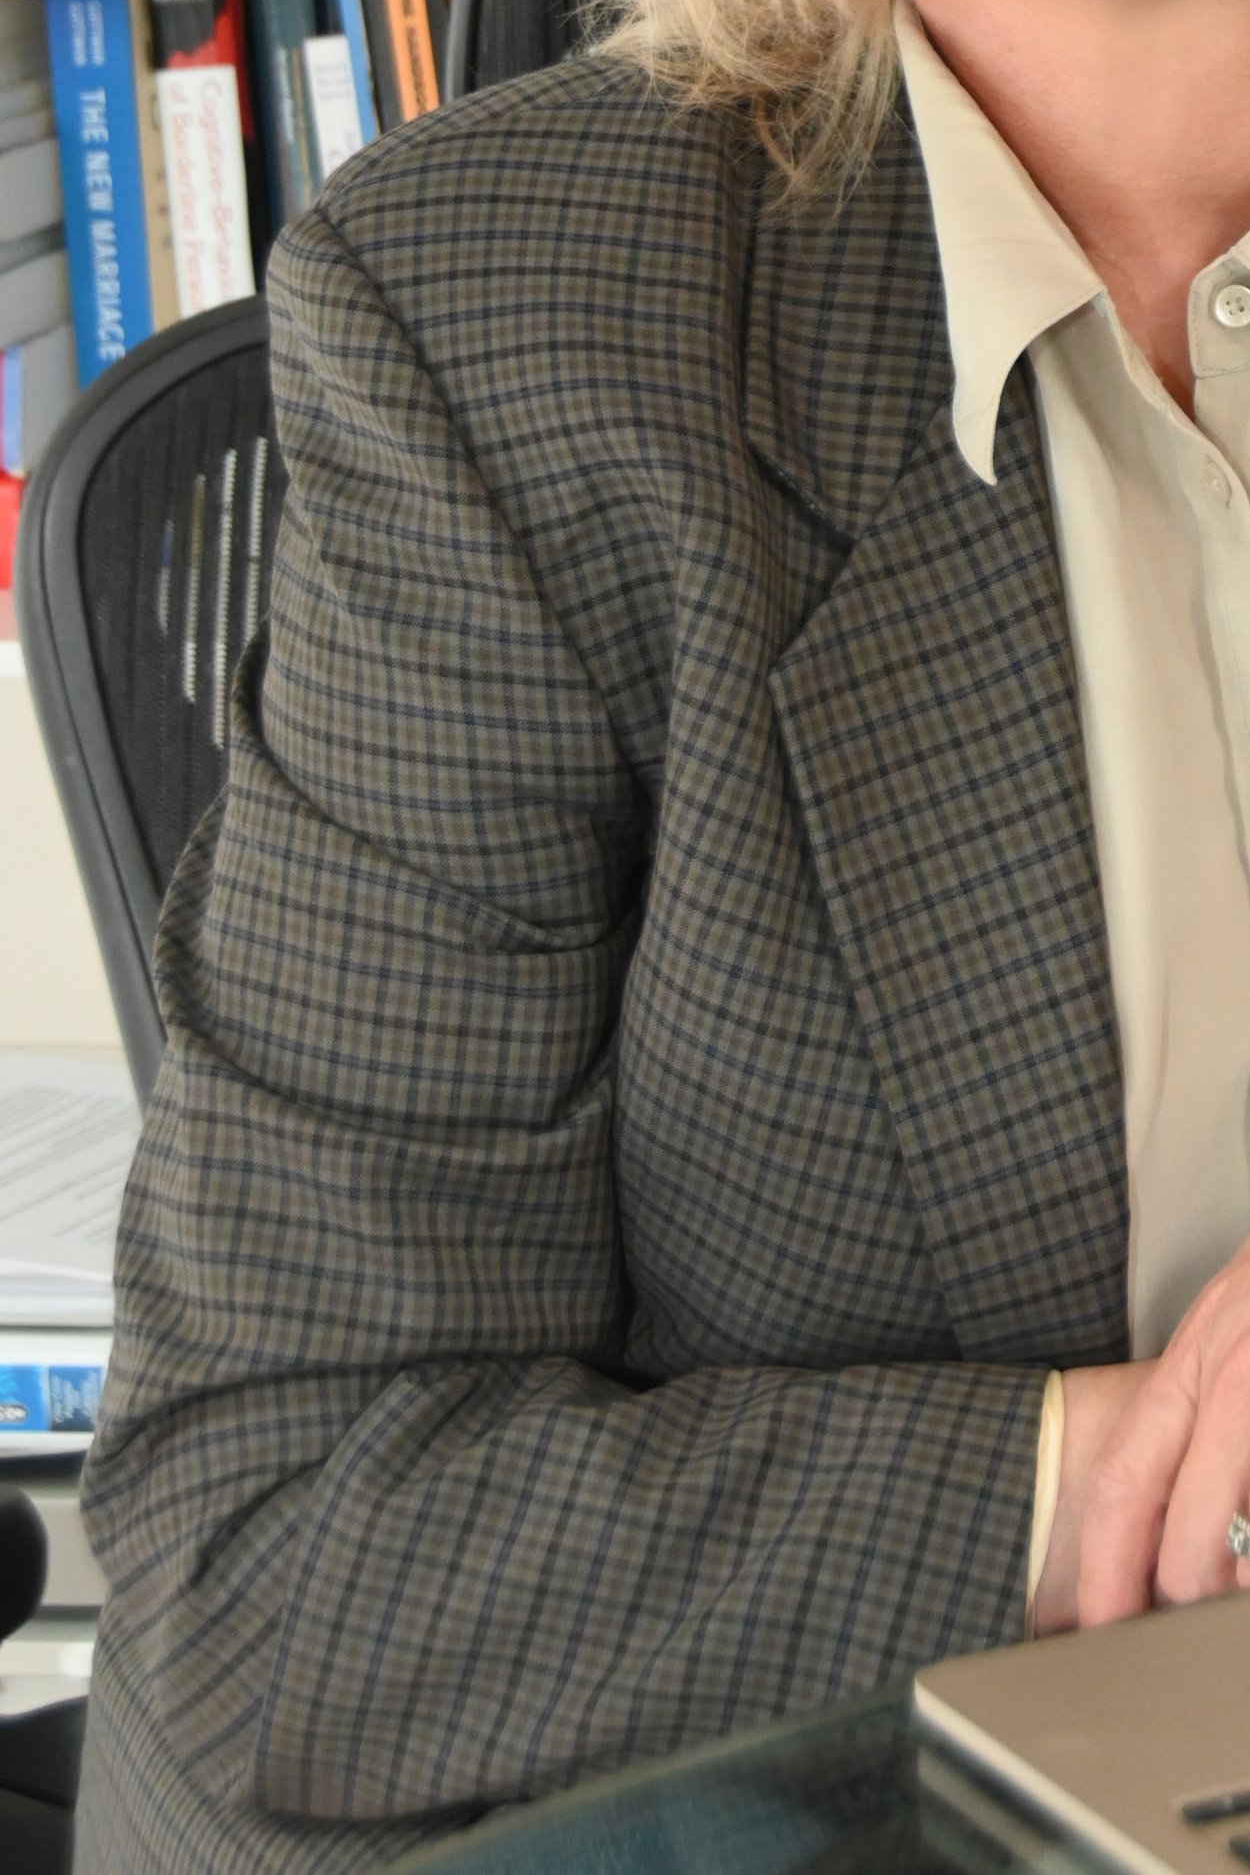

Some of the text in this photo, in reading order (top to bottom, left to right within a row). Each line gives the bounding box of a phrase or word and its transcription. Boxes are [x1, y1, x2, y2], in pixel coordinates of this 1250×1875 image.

[169, 83, 191, 104] of
[80, 87, 127, 362] THE NEW MARRIAGE
[171, 113, 196, 232] Borderline
